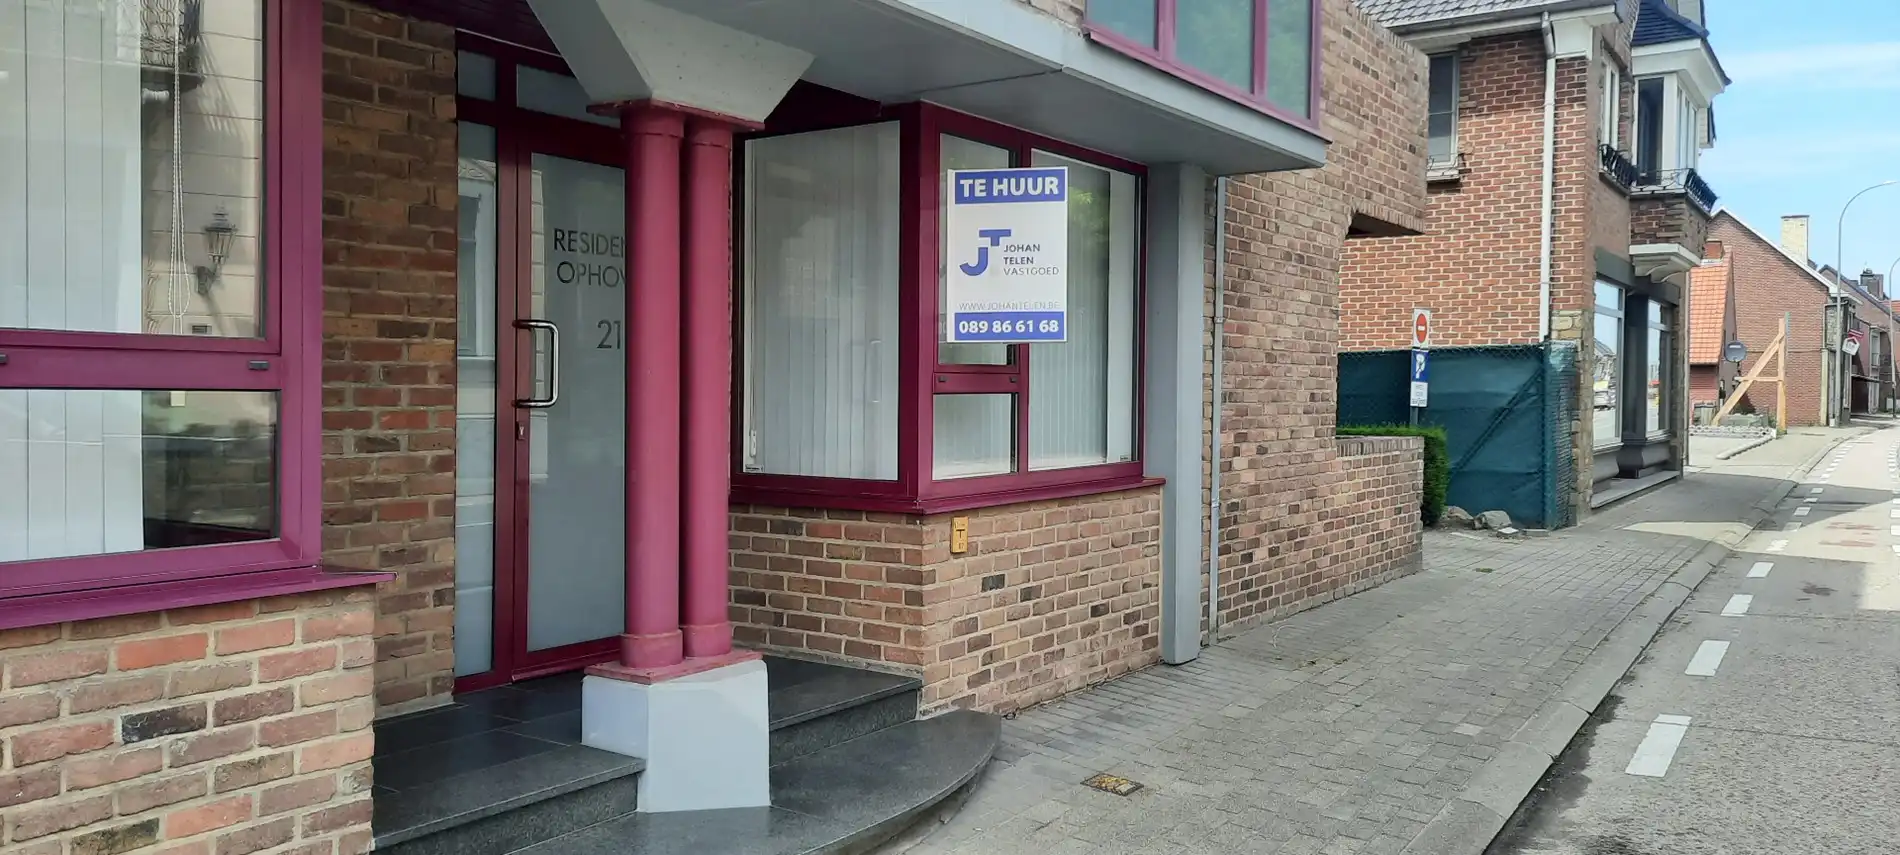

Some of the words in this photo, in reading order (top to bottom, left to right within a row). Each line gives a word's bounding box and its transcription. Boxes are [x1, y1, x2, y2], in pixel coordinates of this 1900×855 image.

[959, 179, 987, 198] TE
[992, 177, 1059, 196] HUUR
[554, 229, 624, 258] RESIDE
[1003, 243, 1041, 253] JOHAN
[1003, 256, 1034, 265] TELEN
[1003, 266, 1059, 276] VASTGOED
[958, 321, 989, 334] 089
[992, 320, 1012, 333] 86
[1015, 320, 1034, 333] 61
[1039, 319, 1059, 333] 68
